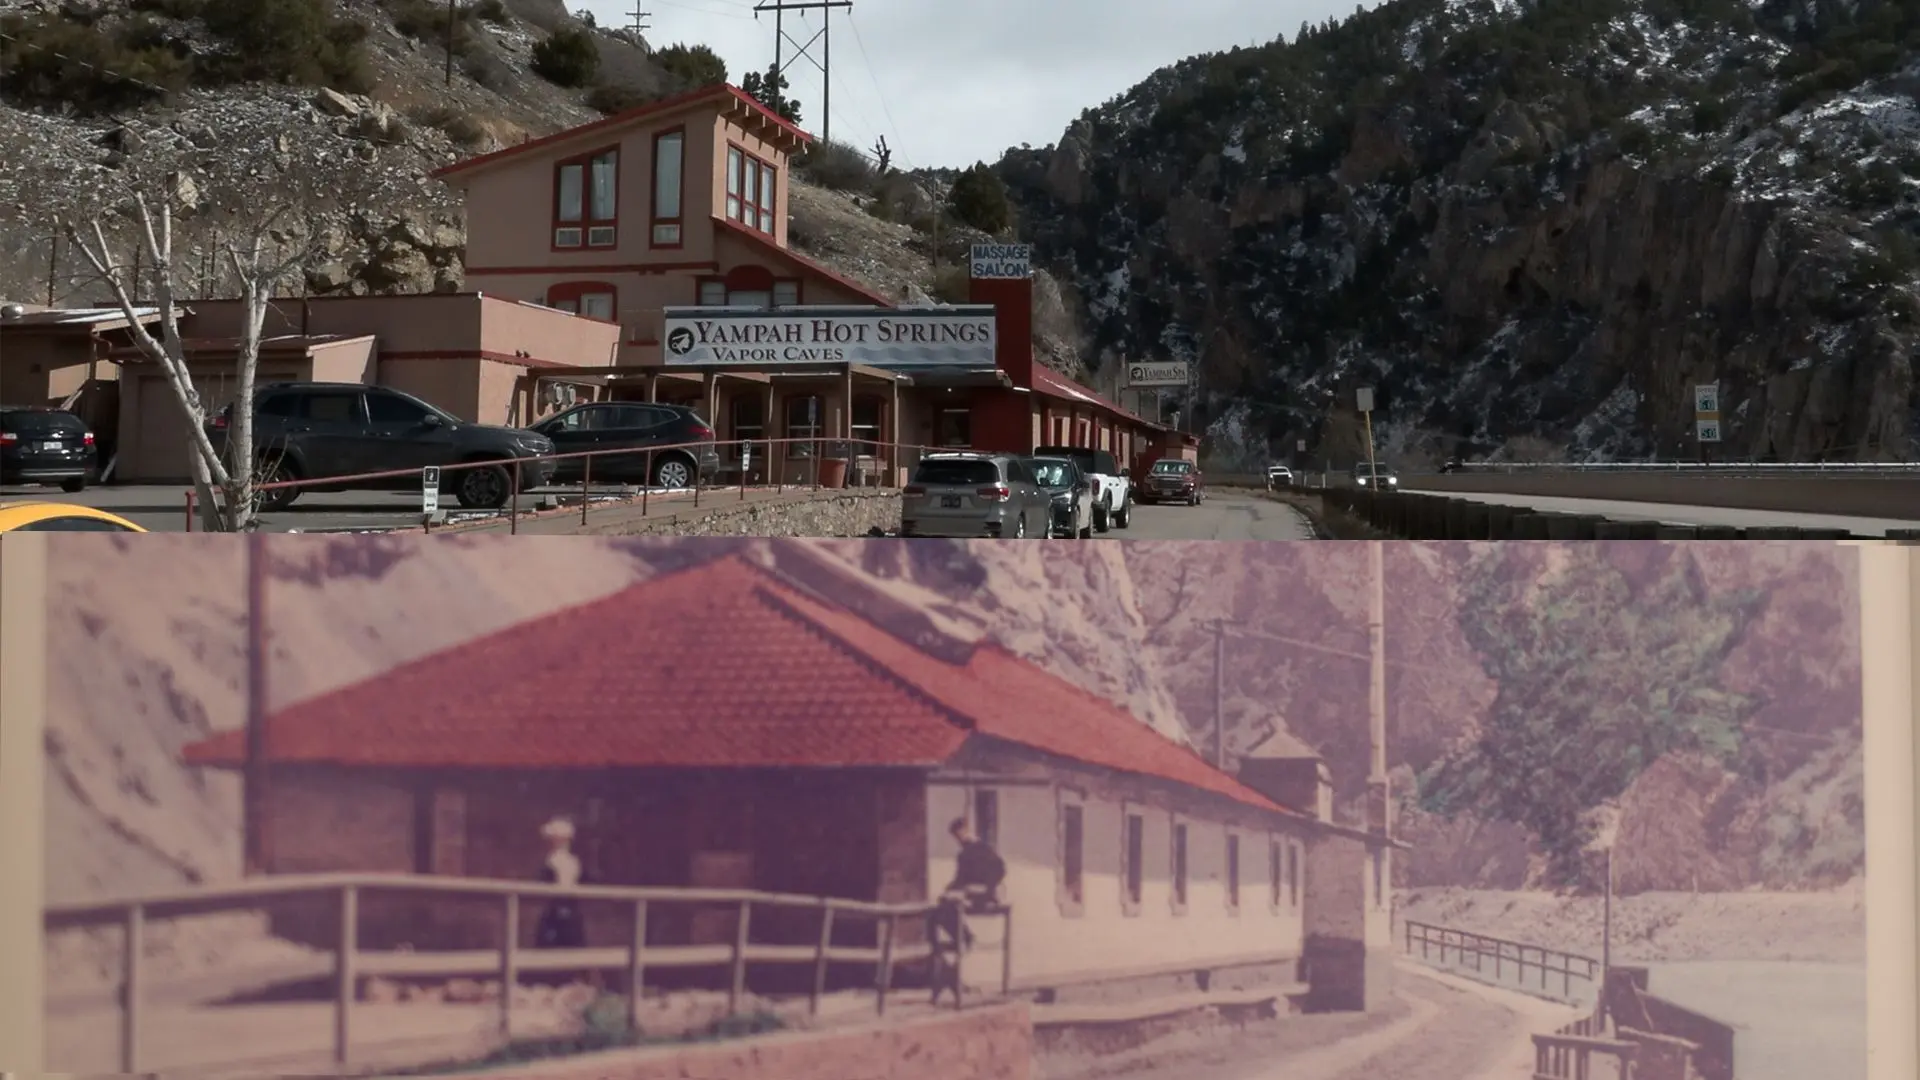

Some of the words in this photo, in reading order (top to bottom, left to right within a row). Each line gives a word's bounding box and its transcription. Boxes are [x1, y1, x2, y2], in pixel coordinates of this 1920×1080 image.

[973, 245, 1029, 259] MASSAGE
[974, 262, 1029, 277] SALON
[694, 320, 804, 344] YAMPAH
[810, 318, 870, 343] HOT
[877, 318, 990, 343] SPRINGS
[712, 346, 778, 361] VAPOR
[783, 346, 844, 361] CAVES
